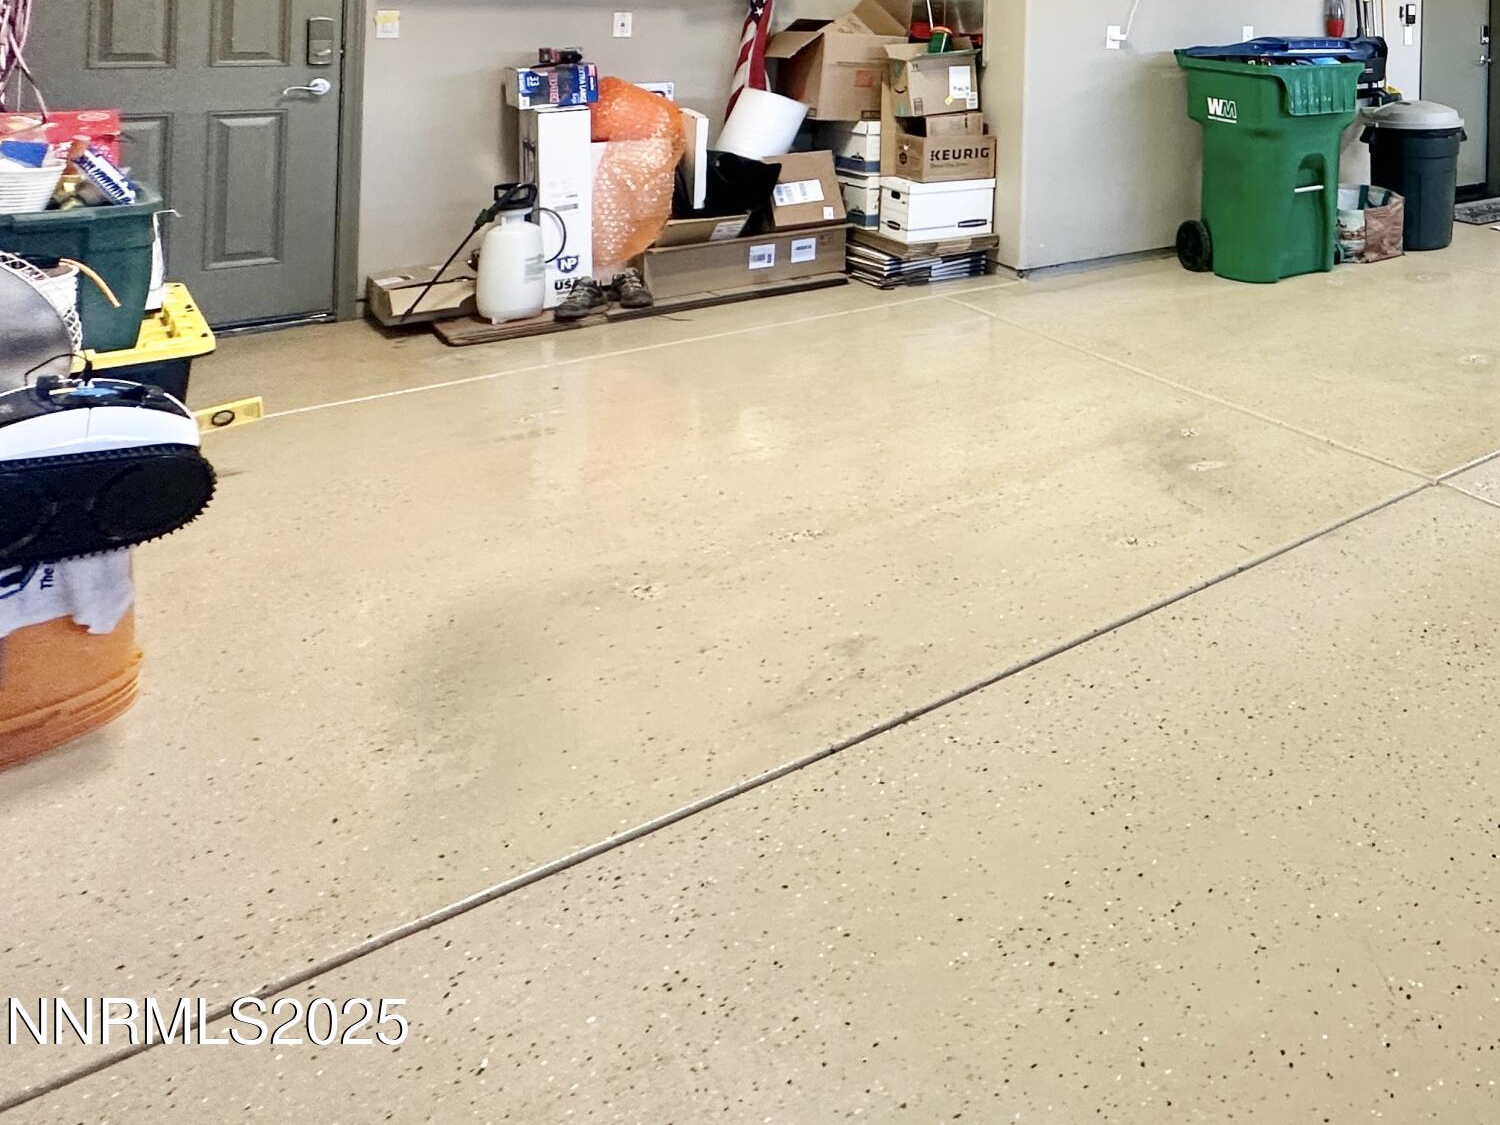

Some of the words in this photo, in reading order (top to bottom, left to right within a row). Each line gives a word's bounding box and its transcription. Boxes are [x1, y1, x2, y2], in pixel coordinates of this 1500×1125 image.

[529, 75, 540, 87] 33
[1207, 97, 1237, 119] WM
[930, 147, 990, 161] KEURIG
[560, 257, 577, 272] NP
[40, 567, 54, 590] The
